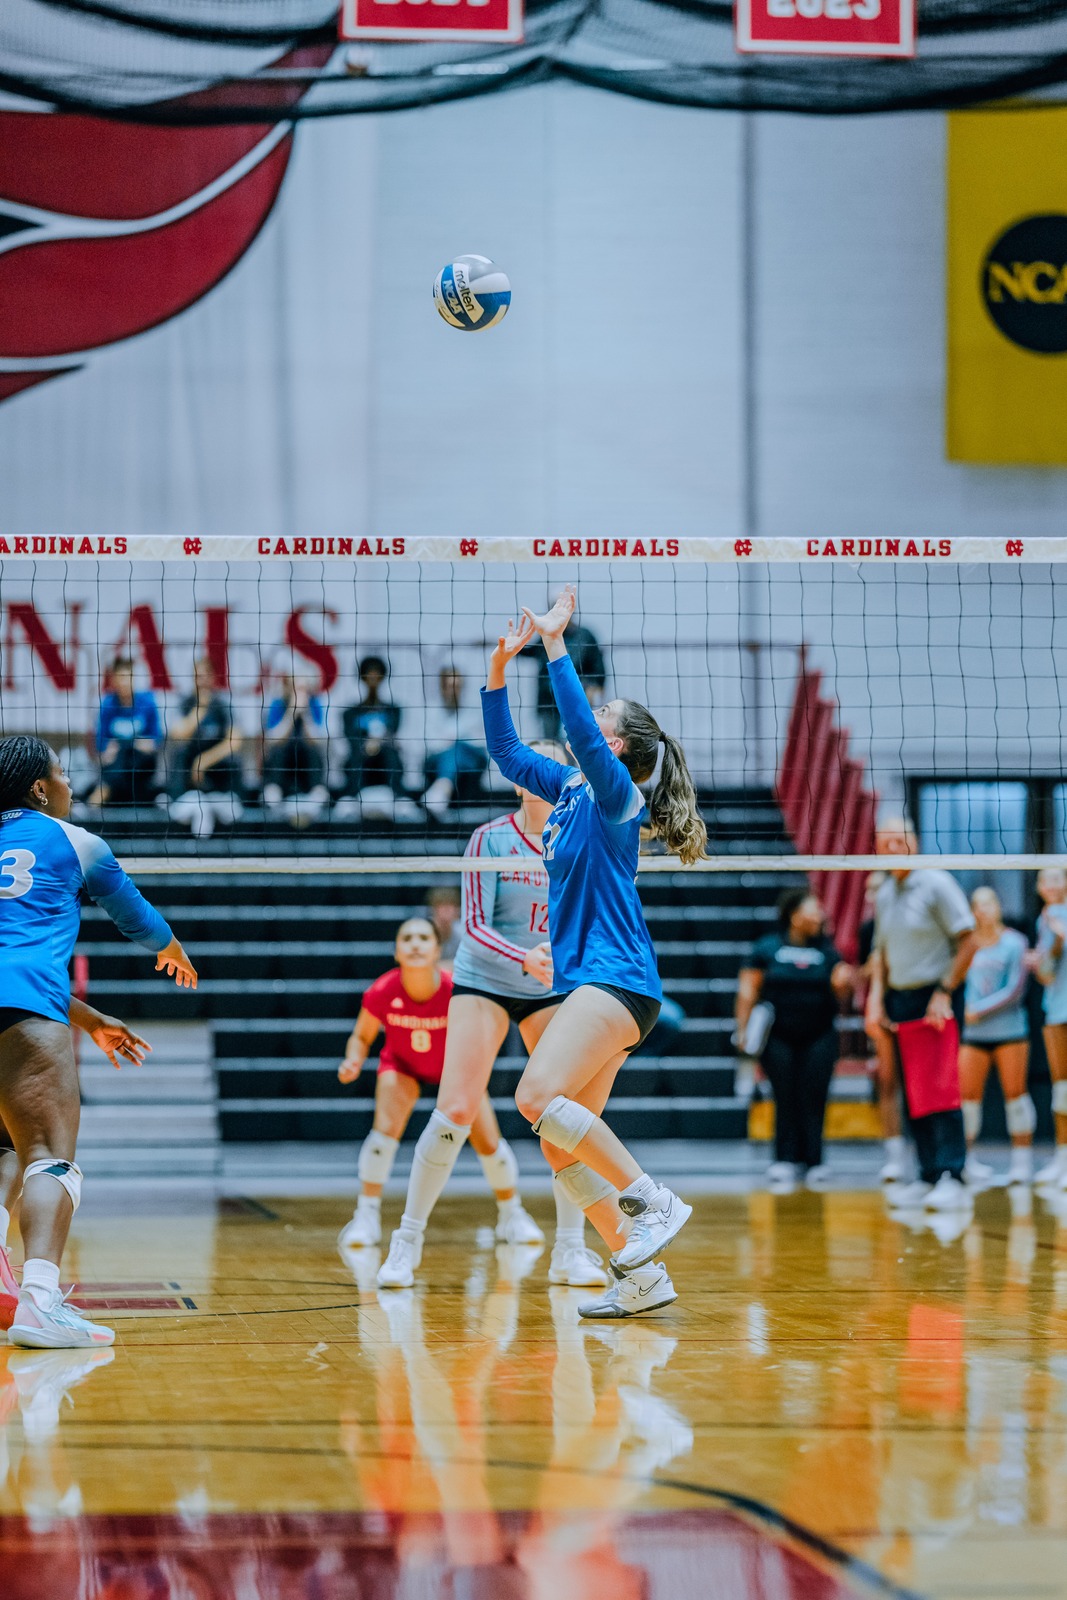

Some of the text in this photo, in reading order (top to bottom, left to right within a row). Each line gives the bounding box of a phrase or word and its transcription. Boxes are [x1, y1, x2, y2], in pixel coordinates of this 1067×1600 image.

[455, 270, 475, 312] molten
[989, 261, 1067, 304] NC
[257, 536, 405, 556] CARDINALS
[533, 538, 679, 557] CARDINALS
[806, 538, 951, 557] CARDINALS
[0, 848, 36, 899] 3
[530, 902, 549, 933] 12
